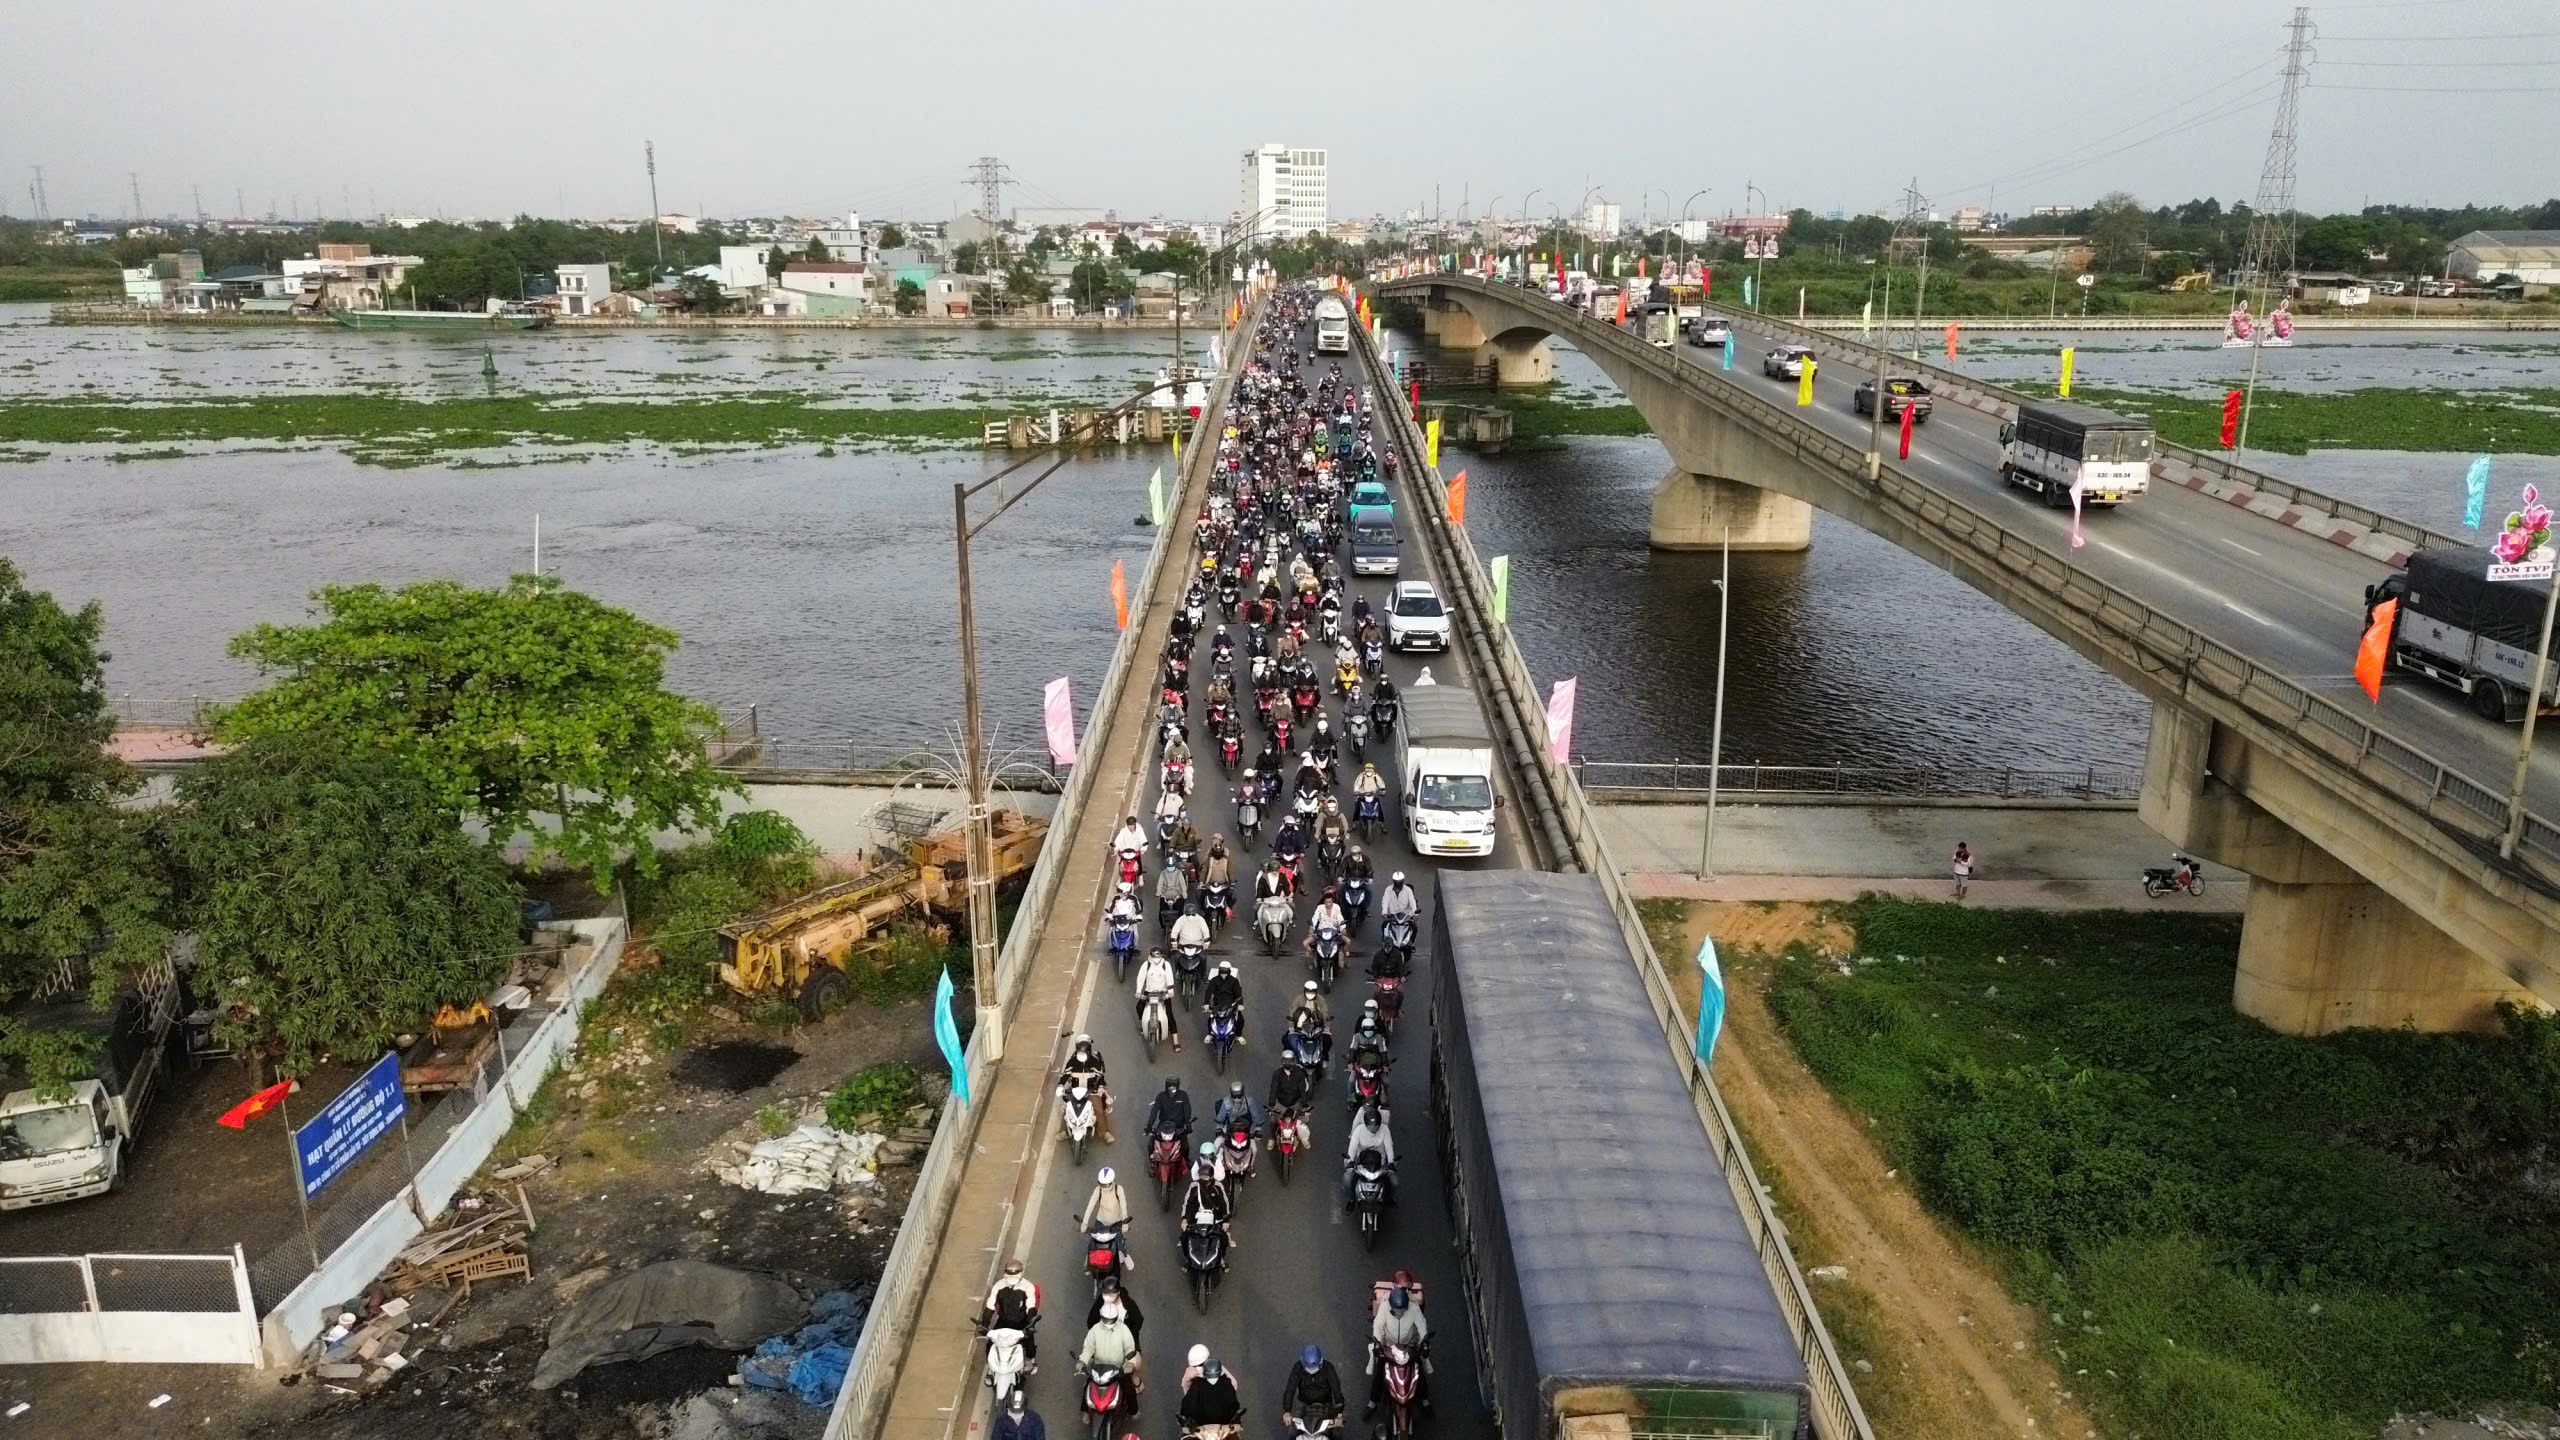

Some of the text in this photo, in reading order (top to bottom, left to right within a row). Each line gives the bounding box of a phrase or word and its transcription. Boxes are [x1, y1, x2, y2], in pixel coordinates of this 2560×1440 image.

[2493, 565, 2550, 574] TÔN TVP
[307, 1145, 324, 1166] HẠT
[323, 1128, 343, 1153] QUẢN
[342, 1118, 351, 1136] LÝ
[351, 1100, 375, 1128] ĐƯỜNG
[374, 1089, 386, 1107] BỘ
[384, 1082, 395, 1097] 1.1
[33, 1158, 65, 1168] ISUZU
